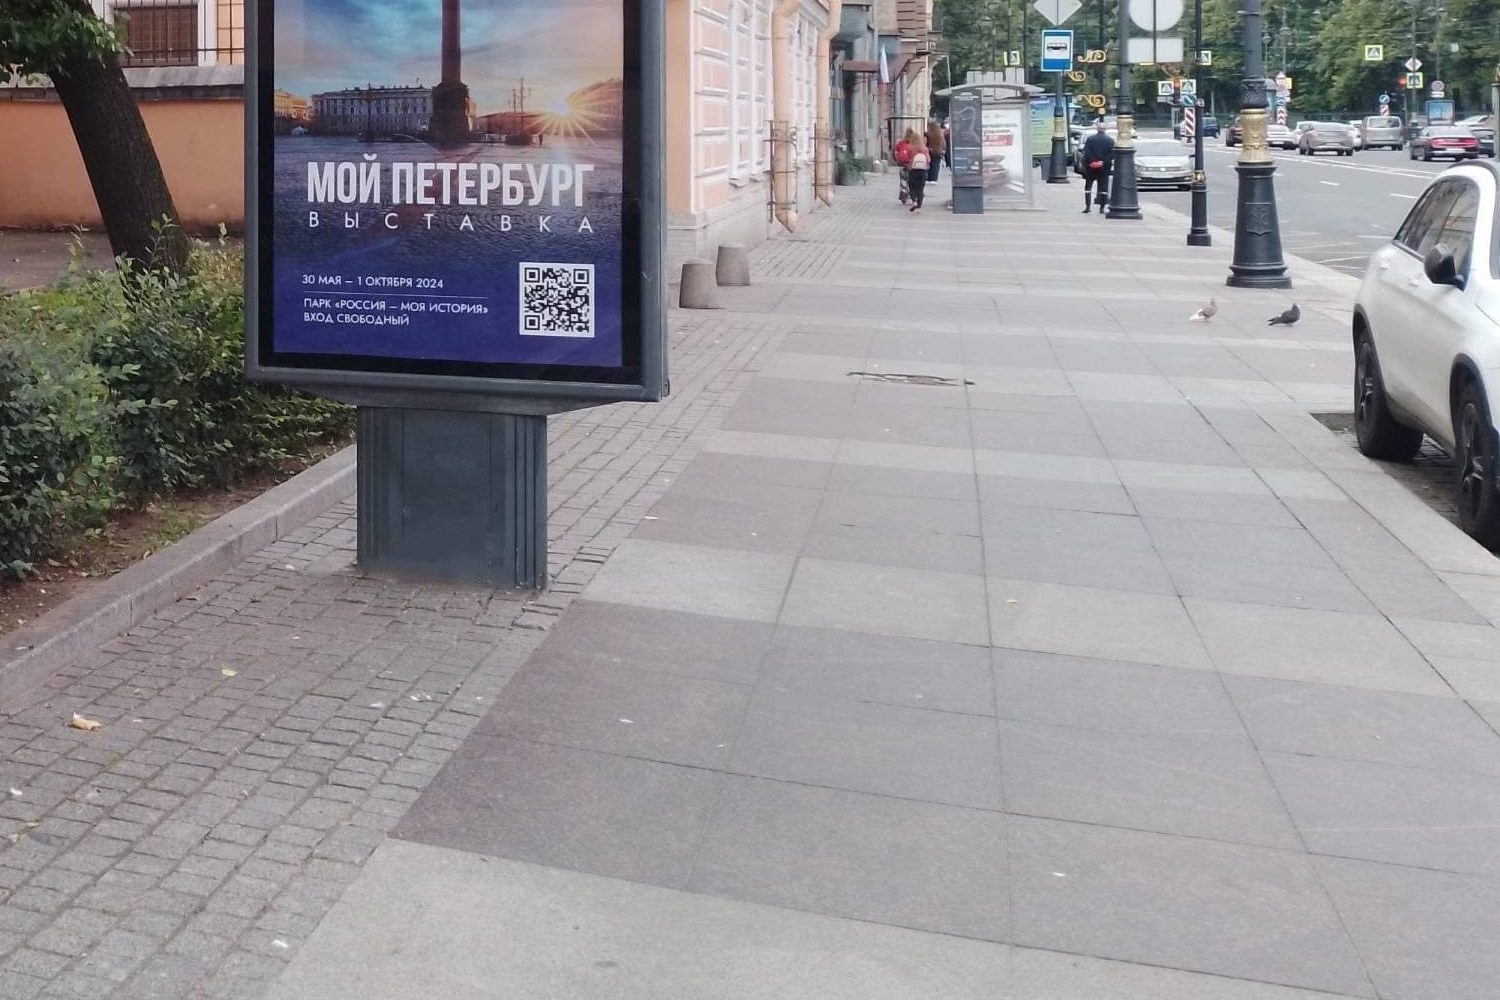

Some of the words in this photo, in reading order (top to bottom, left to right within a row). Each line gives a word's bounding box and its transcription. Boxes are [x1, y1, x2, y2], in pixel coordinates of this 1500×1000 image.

[307, 153, 381, 204] МОЙ
[392, 162, 595, 207] ПЕТЕРБУРГ
[308, 211, 594, 234] ВЫСТАВКА
[302, 274, 315, 285] 30
[318, 275, 342, 286] МАЯ
[357, 276, 362, 286] 1
[365, 276, 413, 288] ОКТЯБРЯ
[416, 278, 444, 289] 2024
[304, 298, 331, 309] ПАРК
[335, 300, 386, 311] «РОССИЯ
[400, 302, 426, 312] МОЯ
[429, 303, 489, 314] ИСТОРИЯ»
[303, 312, 334, 324] ВХОД
[337, 313, 409, 326] СВОБОДНЫЙ
